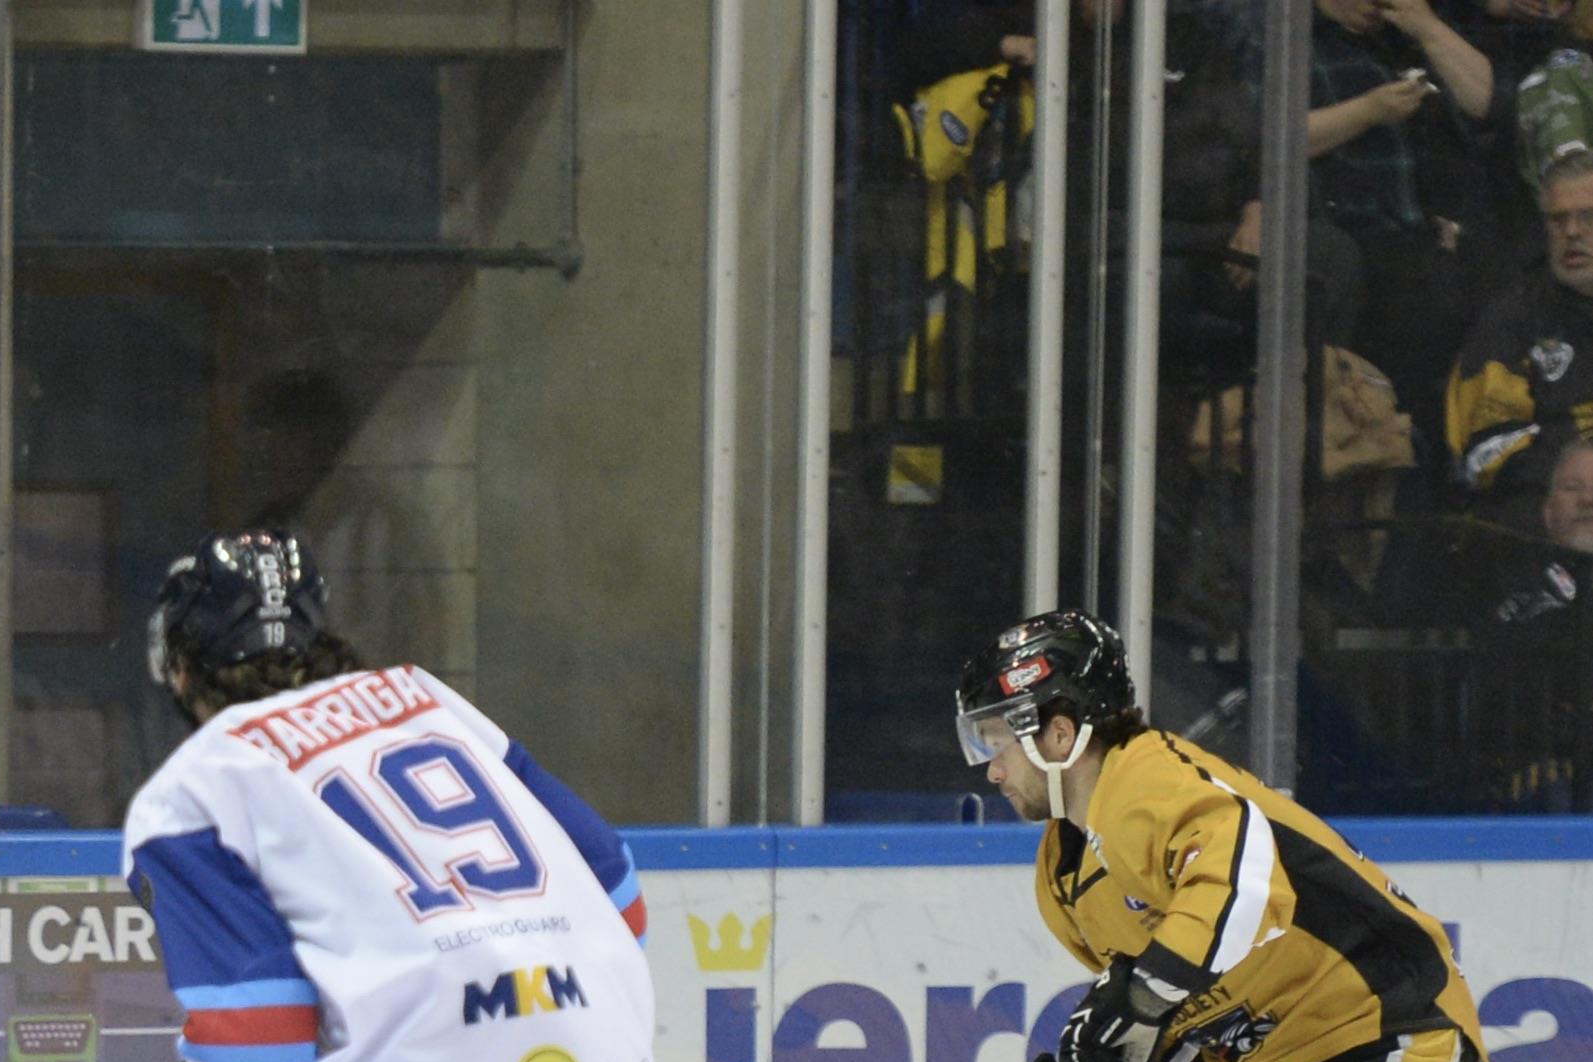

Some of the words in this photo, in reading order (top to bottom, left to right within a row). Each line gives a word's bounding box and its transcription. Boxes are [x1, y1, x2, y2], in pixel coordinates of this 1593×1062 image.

[313, 734, 548, 922] 19
[27, 905, 157, 965] CAR
[463, 965, 589, 1027] MKM
